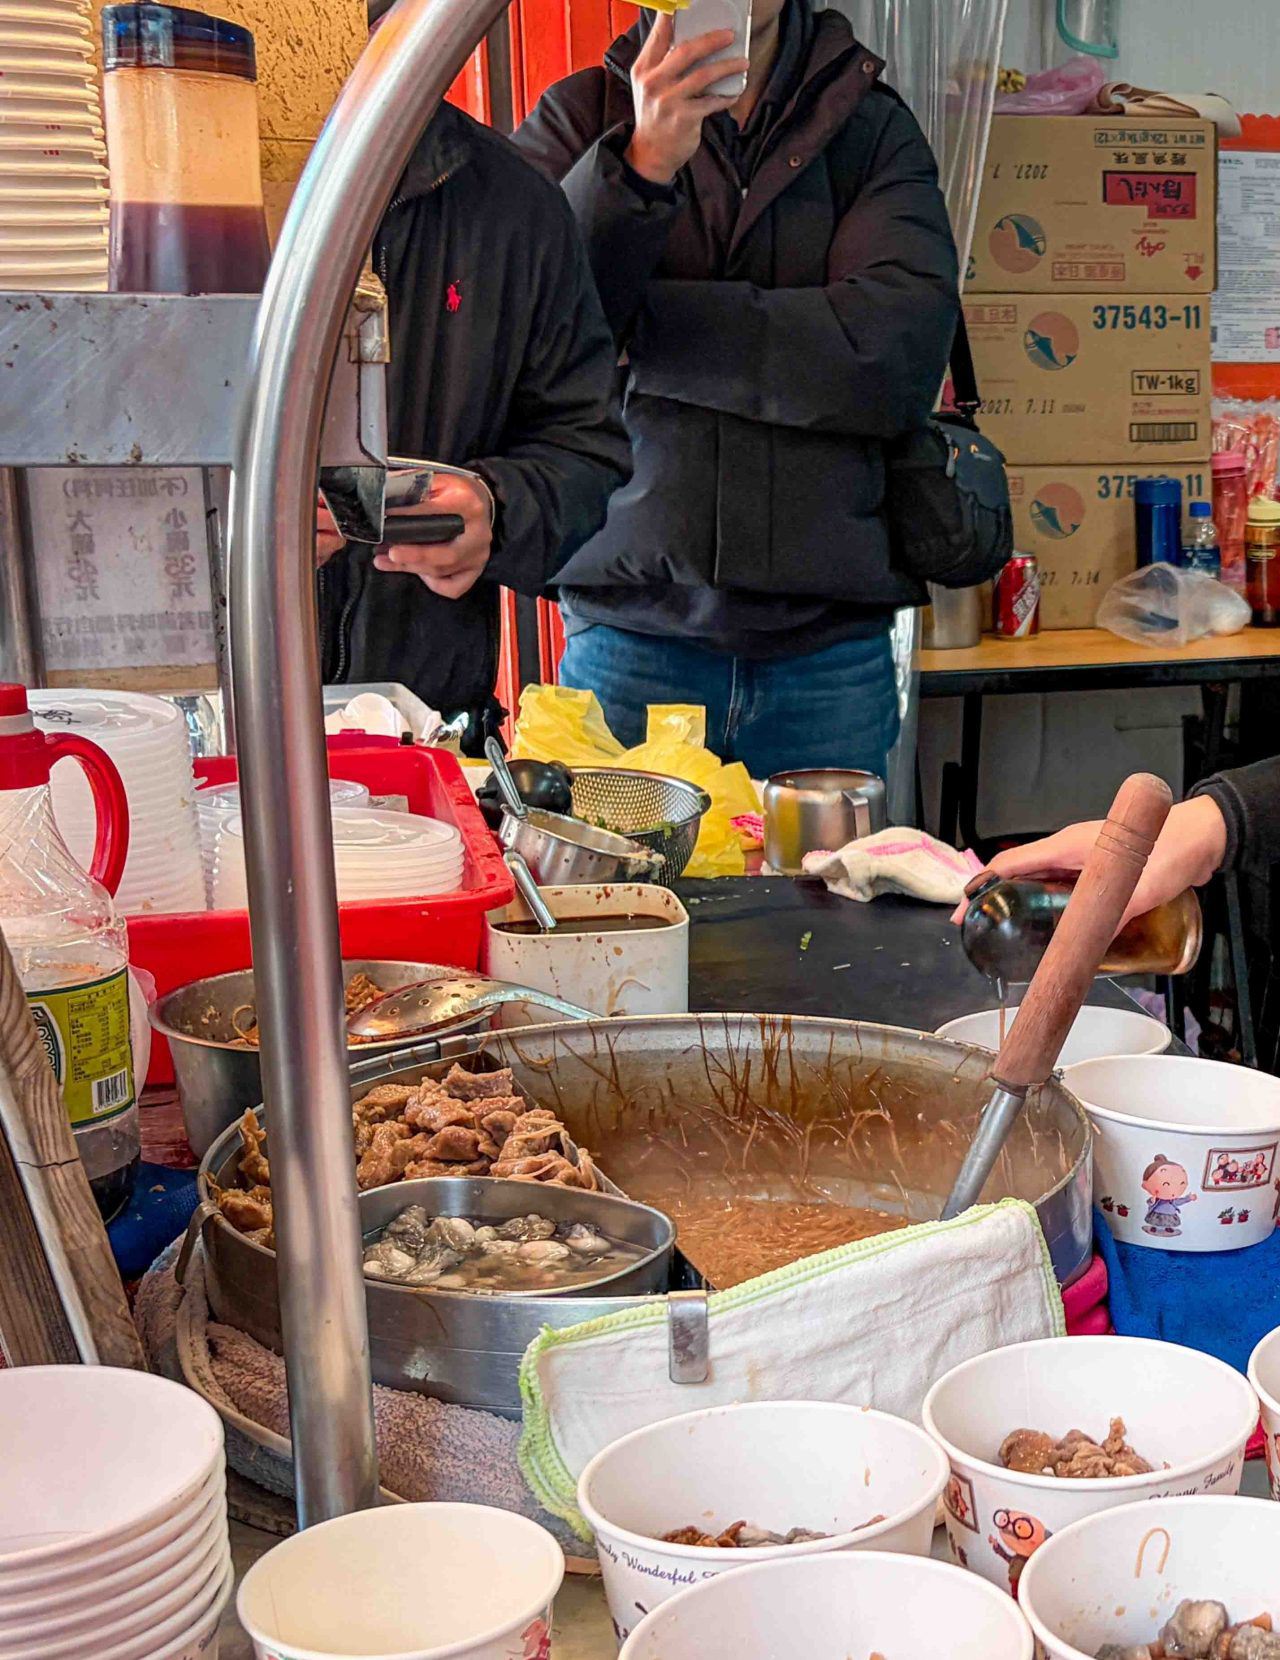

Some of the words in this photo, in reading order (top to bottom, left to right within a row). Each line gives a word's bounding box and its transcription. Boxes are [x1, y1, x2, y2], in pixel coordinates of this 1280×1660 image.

[1093, 304, 1200, 330] 37543-11
[1135, 374, 1197, 393] TW-1kg
[1097, 474, 1203, 499] 37511
[622, 1551, 697, 1585] Wonderful
